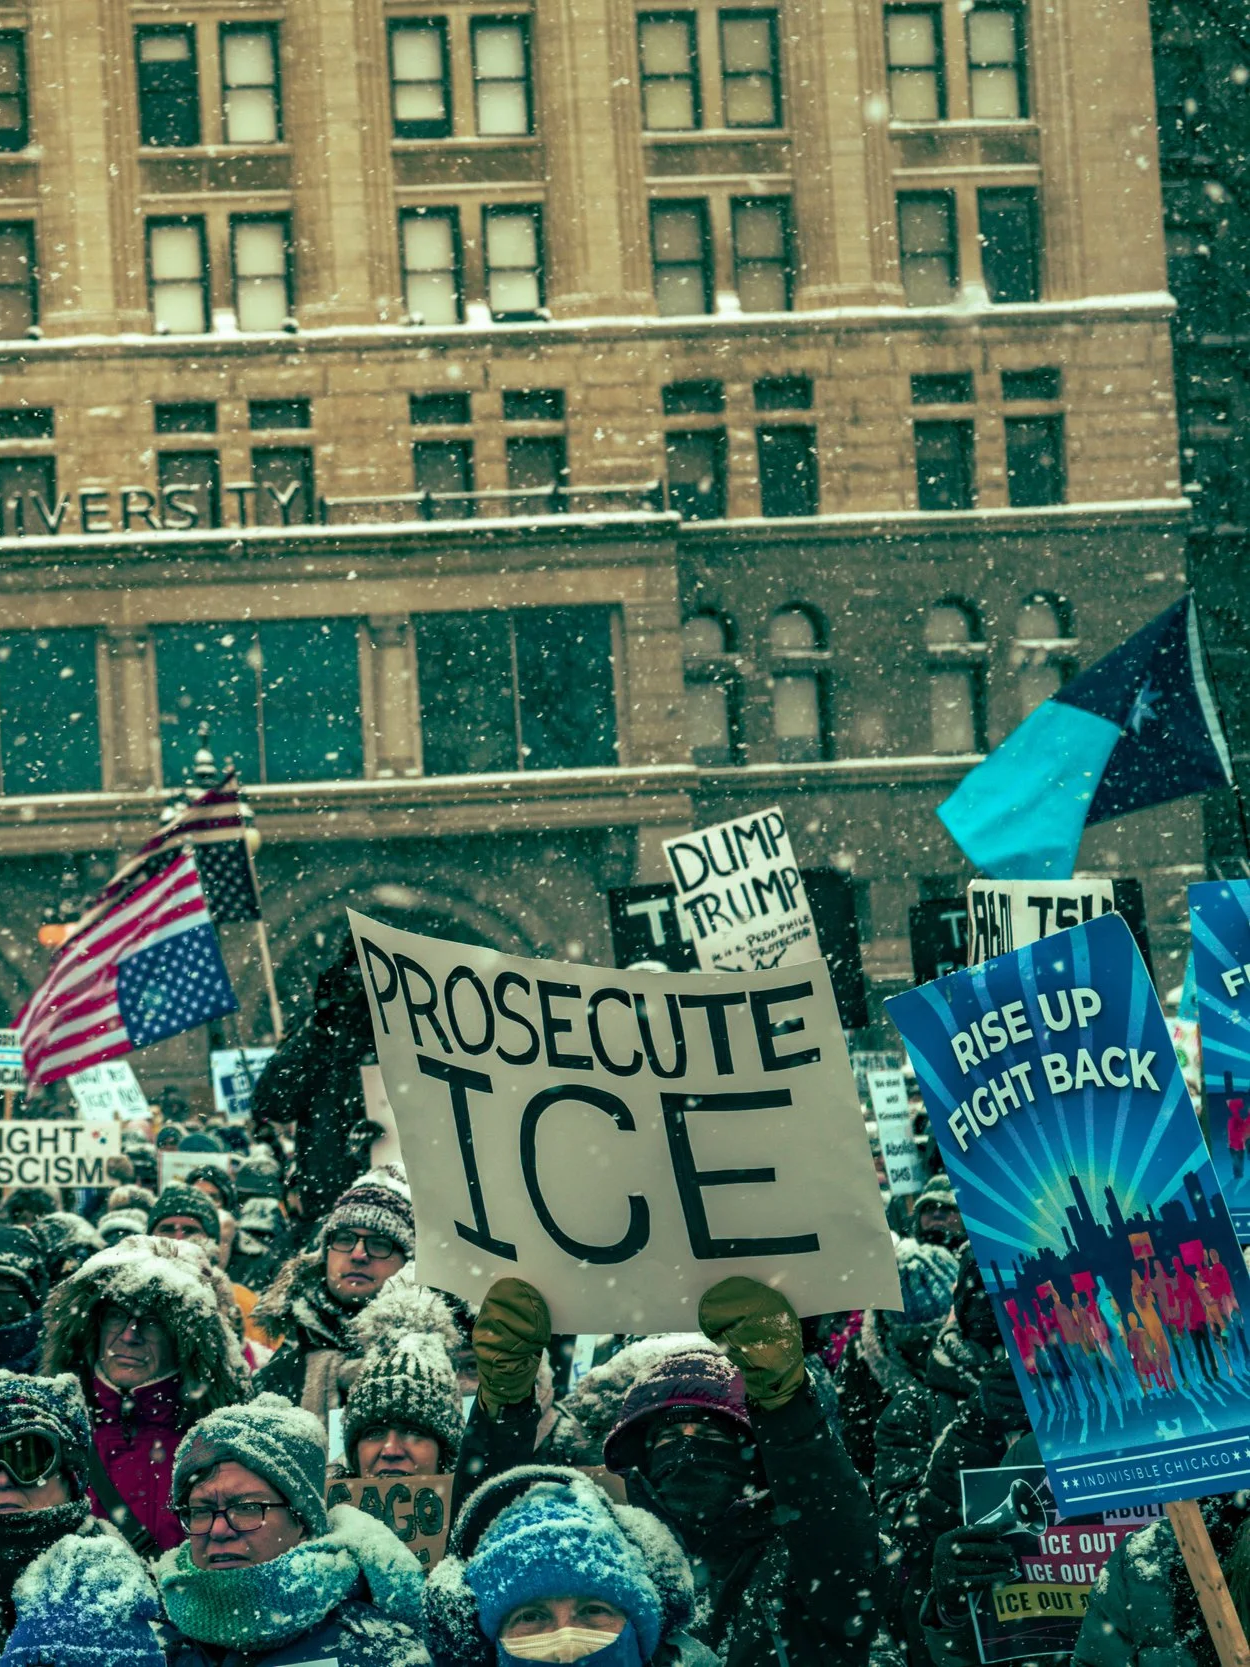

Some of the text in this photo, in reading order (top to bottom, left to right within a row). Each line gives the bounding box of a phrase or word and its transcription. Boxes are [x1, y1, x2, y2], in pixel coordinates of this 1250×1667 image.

[667, 812, 786, 893] DUMP
[683, 866, 800, 940] TRUMP
[747, 926, 812, 961] PROTECTOR
[360, 936, 821, 1079] PROSECUTE
[950, 987, 1102, 1075] RISE UP
[947, 1047, 1161, 1152] FIGHT BACK
[416, 1053, 820, 1265] ICE
[1082, 1452, 1231, 1488] INDIVISIBLE CHICAGO
[1105, 1502, 1165, 1520] ABOLI
[1040, 1534, 1072, 1555] ICE
[1078, 1532, 1117, 1554] OUT
[1025, 1563, 1097, 1583] ICE OUT
[996, 1592, 1034, 1615] ICE
[1037, 1592, 1078, 1612] OUT
